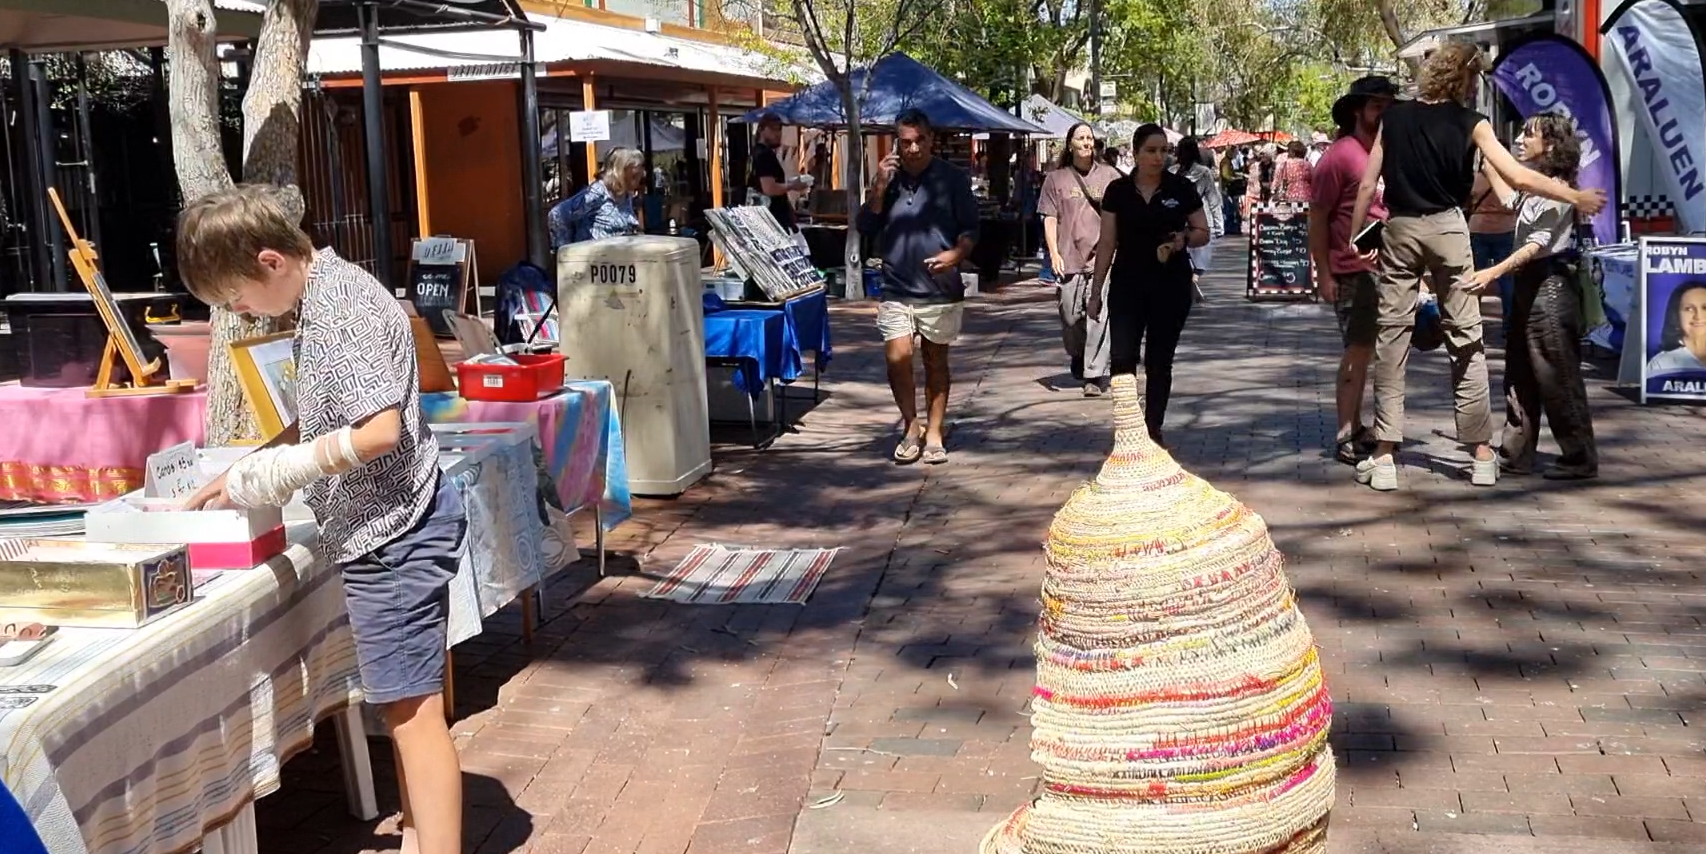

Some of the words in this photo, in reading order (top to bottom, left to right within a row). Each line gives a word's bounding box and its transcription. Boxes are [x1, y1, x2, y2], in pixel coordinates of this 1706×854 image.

[1617, 25, 1705, 201] ARALUEN
[1646, 246, 1688, 256] ROBYN
[590, 264, 636, 284] P0079
[416, 282, 449, 298] OPEN
[1662, 380, 1706, 393] ARAL
